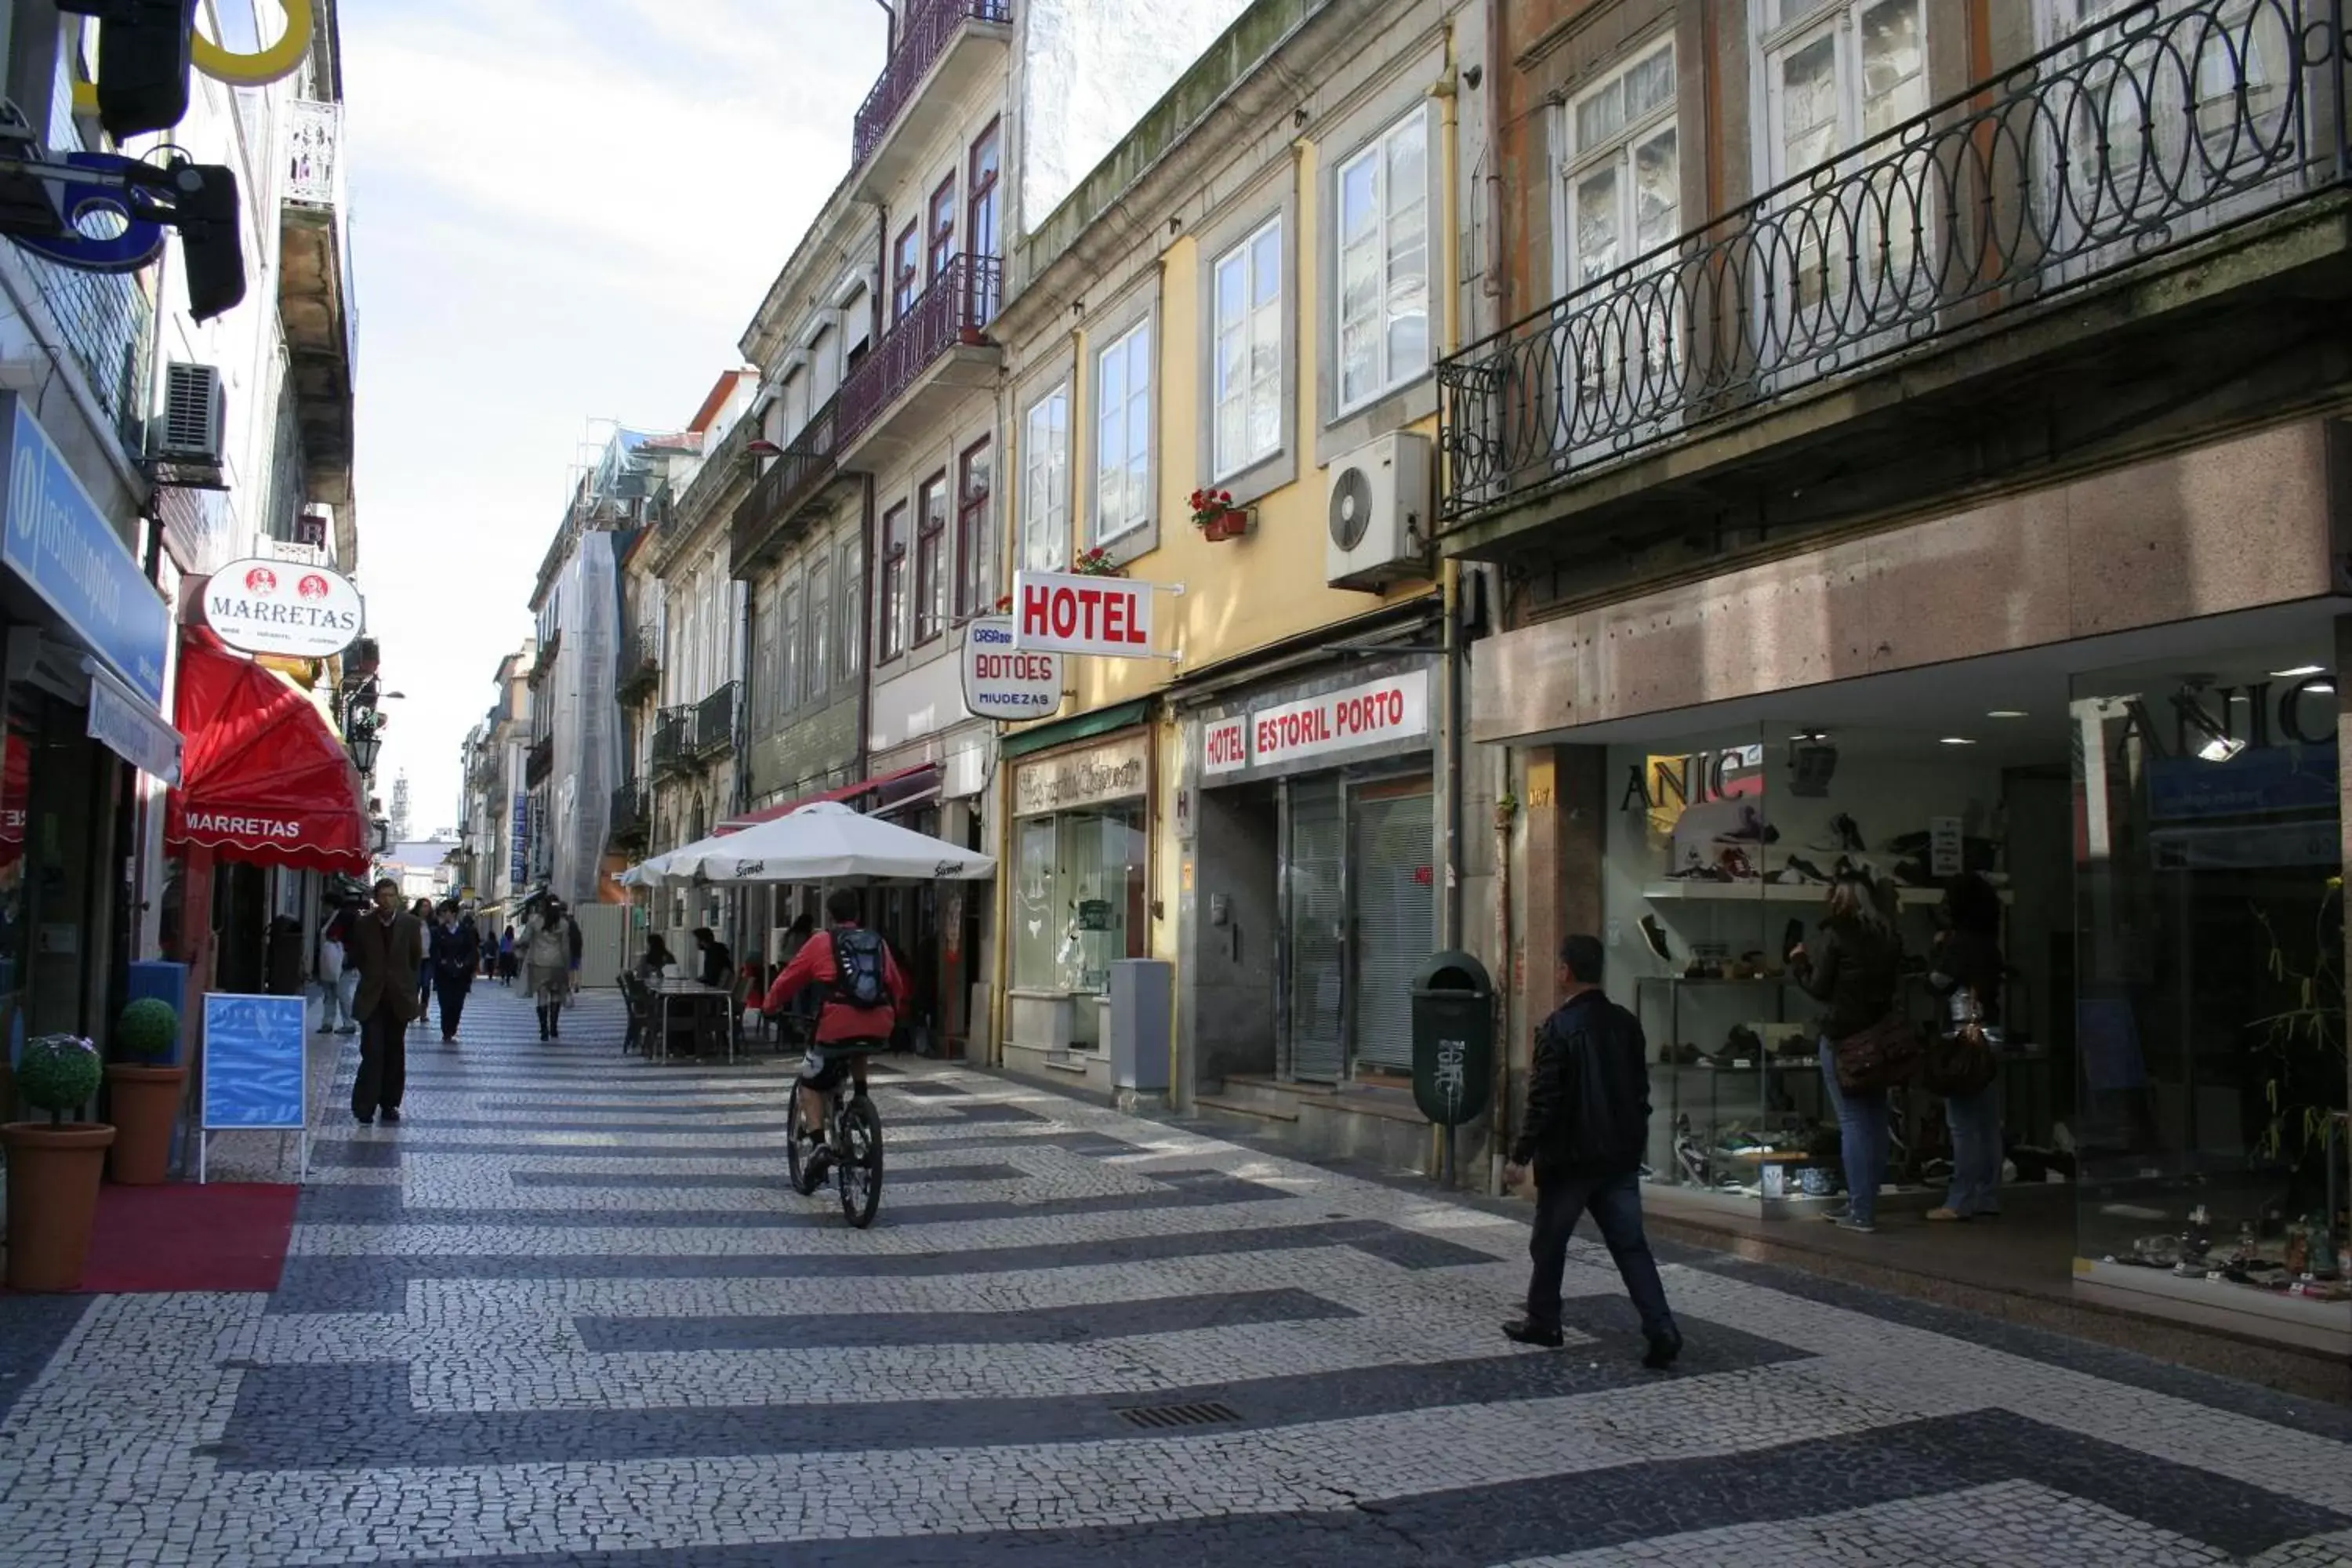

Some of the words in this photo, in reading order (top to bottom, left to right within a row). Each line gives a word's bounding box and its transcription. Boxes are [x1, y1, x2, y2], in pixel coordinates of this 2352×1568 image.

[211, 596, 355, 630] MARRETAS
[1023, 584, 1146, 644] HOTEL
[974, 629, 999, 644] CASA
[979, 693, 1049, 706] MIUDEZAS
[1207, 725, 1245, 766] HOTEL
[1258, 707, 1331, 753] ESTORIL
[1337, 689, 1404, 738] PORTO
[1620, 752, 1744, 811] ANIC
[186, 812, 299, 837] MARRETAS
